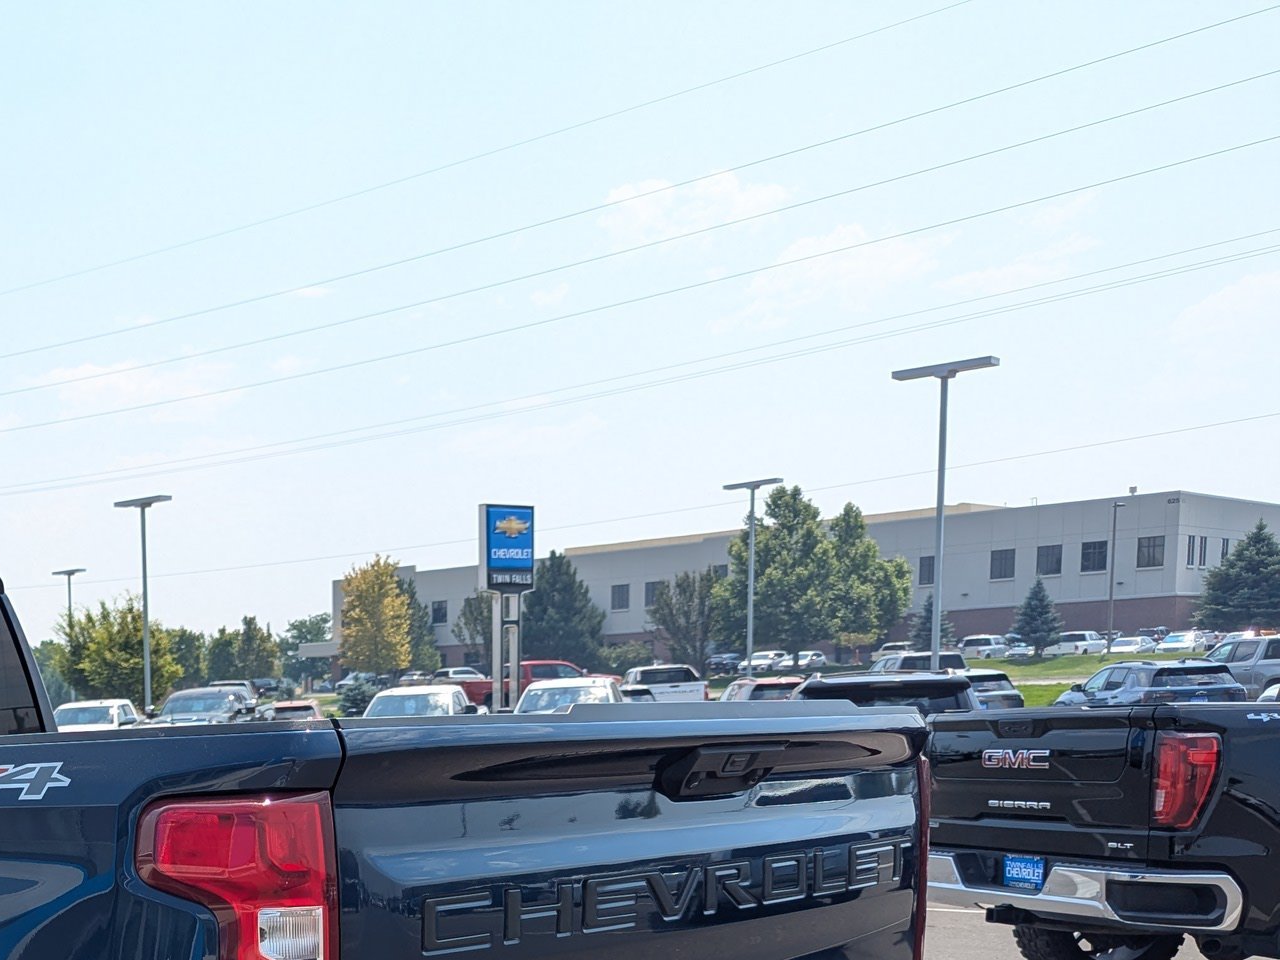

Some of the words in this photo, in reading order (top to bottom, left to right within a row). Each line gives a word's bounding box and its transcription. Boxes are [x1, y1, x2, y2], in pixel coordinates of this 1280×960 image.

[491, 548, 532, 559] CHEVROLET
[492, 574, 510, 584] TWIN
[511, 574, 532, 584] FALLS
[982, 749, 1050, 769] GMC
[988, 800, 1051, 809] SIERRA
[1006, 867, 1044, 880] CHEVROLET
[421, 837, 912, 957] CHEVROLET
